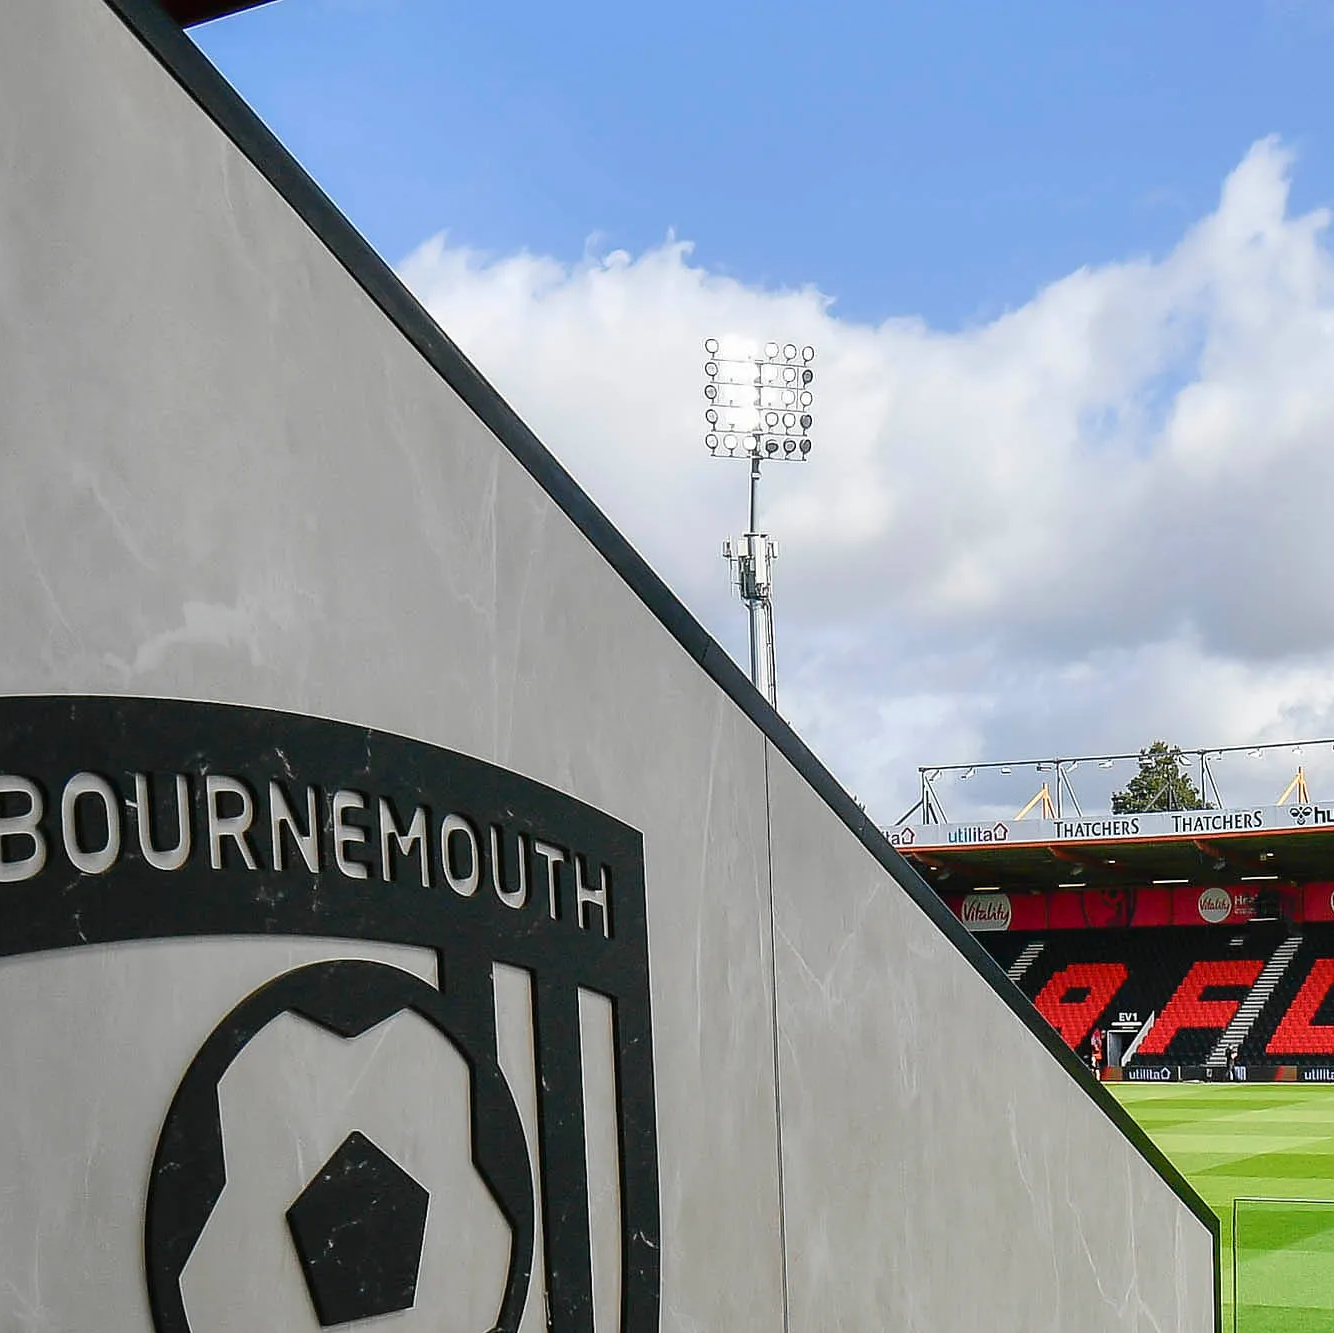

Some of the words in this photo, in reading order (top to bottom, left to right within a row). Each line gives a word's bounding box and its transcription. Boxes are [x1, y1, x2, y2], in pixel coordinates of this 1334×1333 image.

[1054, 818, 1140, 838] THATCHERS
[1172, 811, 1264, 832] THATCHERS
[949, 827, 993, 843] utilita
[964, 902, 1010, 927] Vitality
[1119, 1012, 1138, 1022] EV1
[1129, 1068, 1161, 1080] utilita
